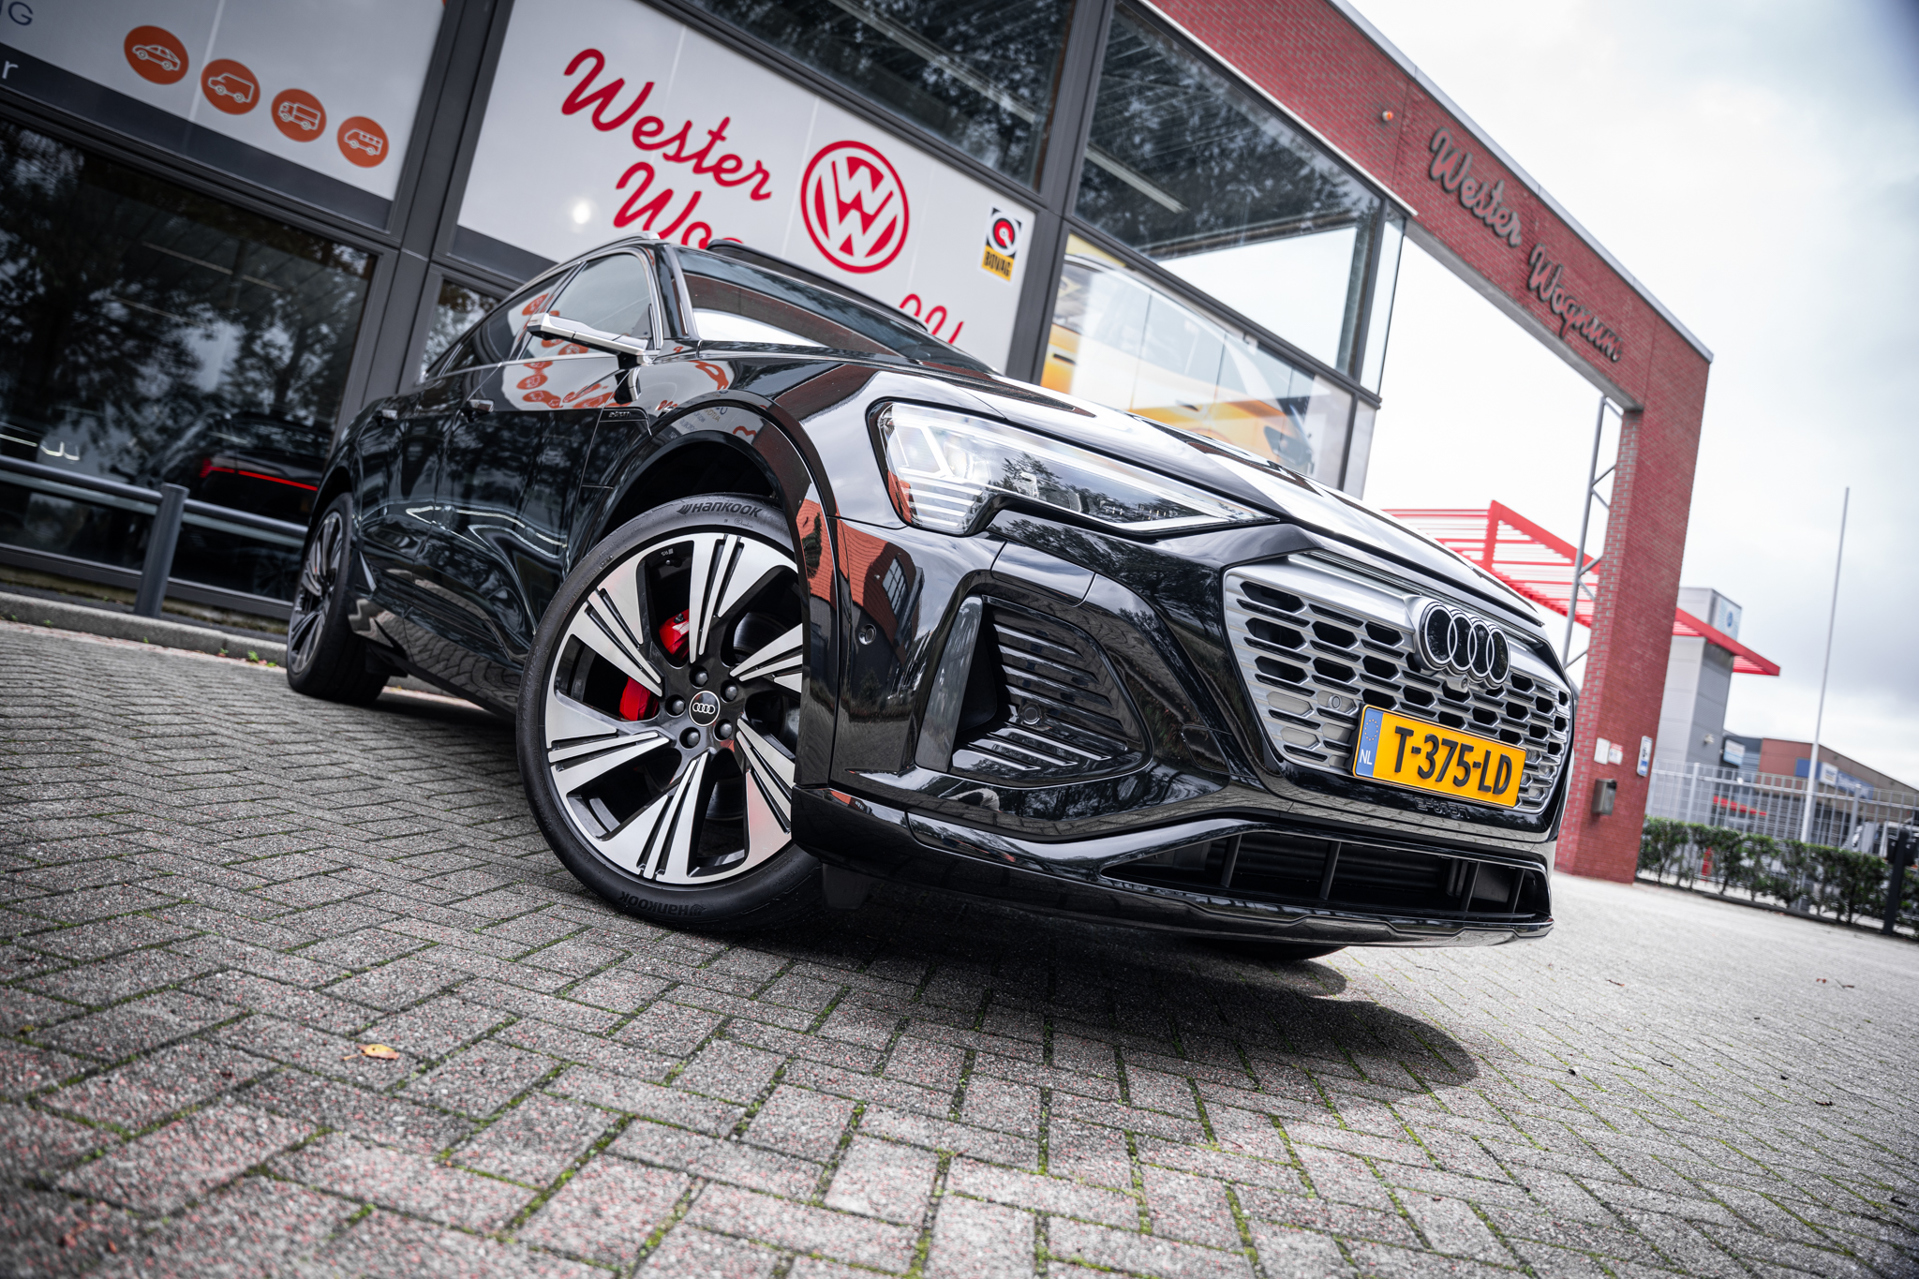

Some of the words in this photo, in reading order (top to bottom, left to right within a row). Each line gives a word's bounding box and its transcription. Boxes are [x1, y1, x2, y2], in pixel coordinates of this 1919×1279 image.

[562, 48, 772, 201] Wester
[1429, 127, 1522, 248] Wester
[1359, 748, 1373, 766] NL
[1395, 725, 1513, 795] T-375-LD
